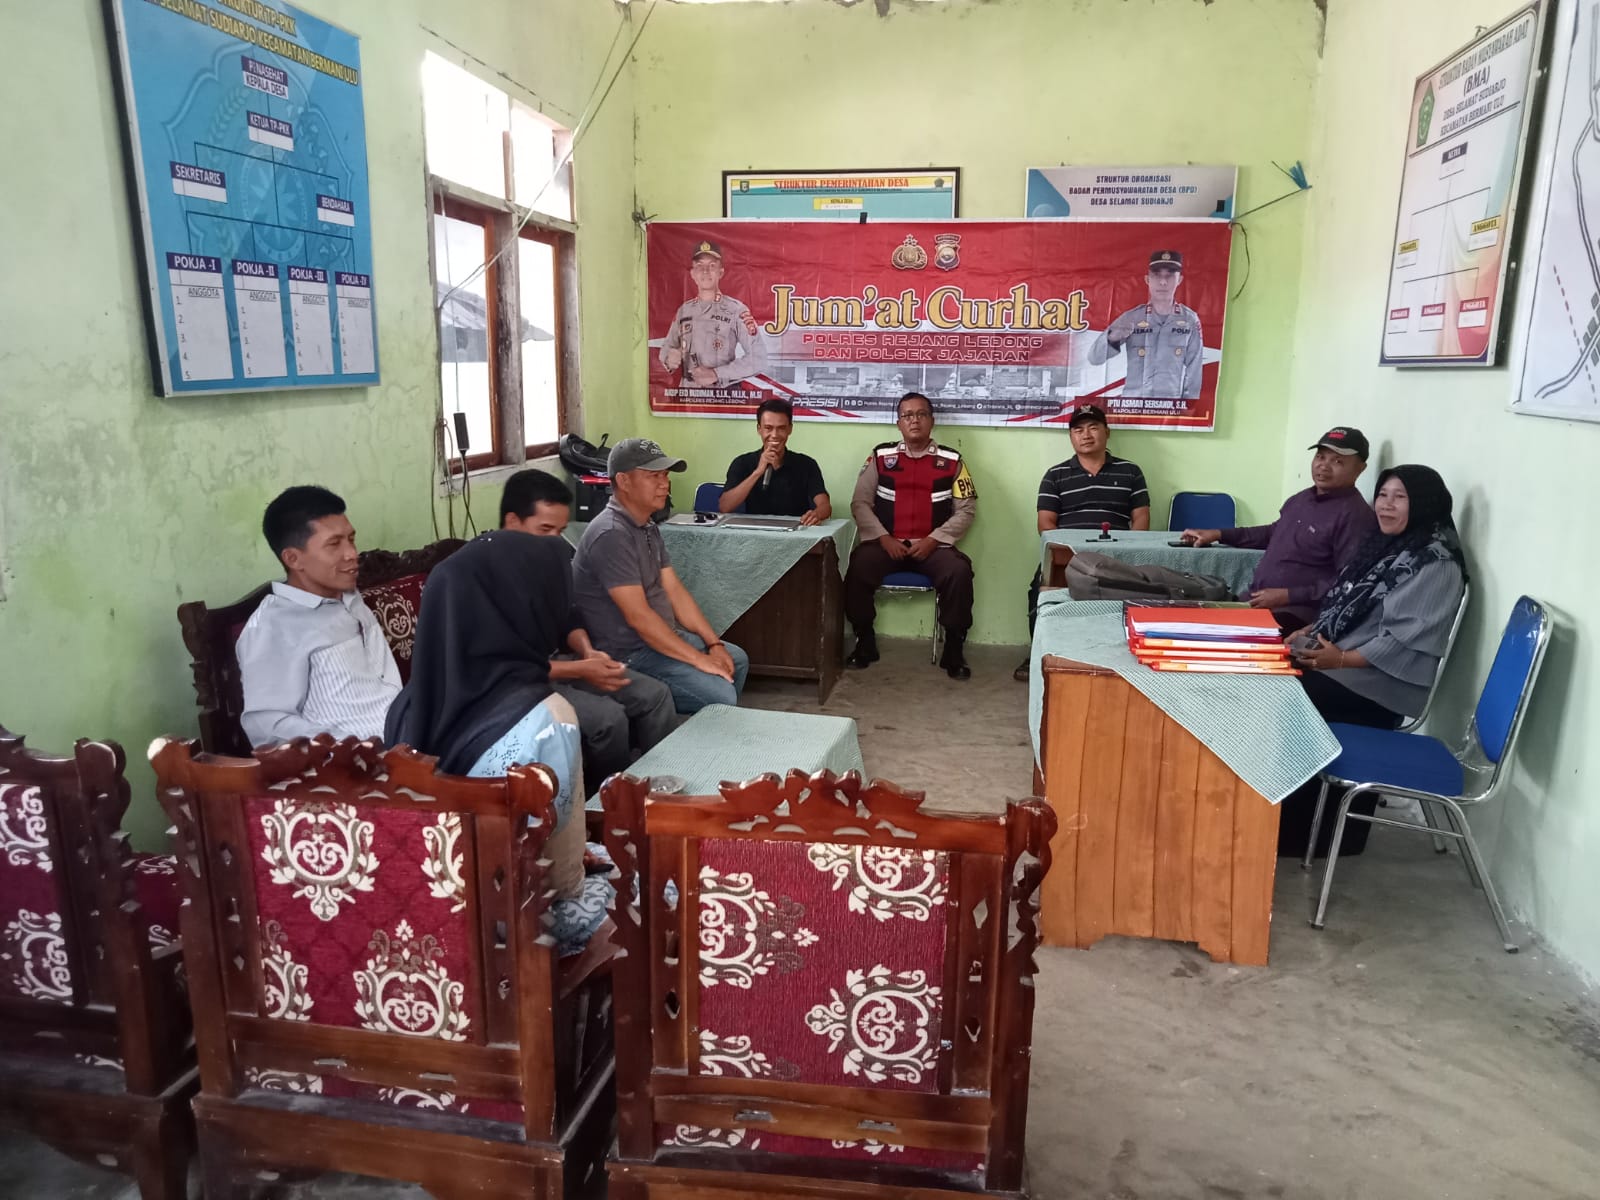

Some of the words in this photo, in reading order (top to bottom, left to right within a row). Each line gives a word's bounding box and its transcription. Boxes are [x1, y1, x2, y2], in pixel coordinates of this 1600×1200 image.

[218, 0, 264, 22] UKTUR
[209, 9, 255, 43] SUDIARJO
[310, 52, 343, 79] BERMANI
[344, 67, 358, 85] ULU
[249, 60, 284, 83] PENASEHAT
[246, 74, 270, 92] KEPALA
[271, 83, 287, 98] DESA
[1464, 65, 1490, 96] (BMA)
[250, 113, 269, 129] KETUA
[270, 119, 290, 135] TP-PKK
[175, 164, 221, 185] SEKRETARIS
[1096, 175, 1129, 183] STRUKTUR
[1131, 175, 1171, 183] ORGANISASI
[774, 180, 817, 189] STRUKTUR
[820, 178, 885, 188] PEMERINTAHAN
[887, 178, 909, 187] DESA
[321, 196, 350, 212] BENDAHARA
[174, 256, 206, 270] POKJA
[236, 262, 264, 275] POKJA
[290, 268, 313, 281] POKJA
[341, 274, 357, 285] POKJA
[188, 287, 220, 297] ANGGOTA
[250, 291, 277, 301] ANGGOTA
[765, 285, 921, 337] Jum'at
[926, 283, 1088, 331] Curhat
[711, 314, 731, 323] POLRI
[803, 334, 877, 346] POLRES
[882, 335, 961, 347] REJANG
[964, 336, 1043, 348] LEBONG
[814, 348, 851, 360] DAN
[856, 348, 933, 361] POLSEK
[938, 349, 1030, 362] JAJARAN
[792, 397, 840, 407] PRESISI
[1107, 399, 1120, 407] IPTU
[1176, 401, 1188, 409] S.H.
